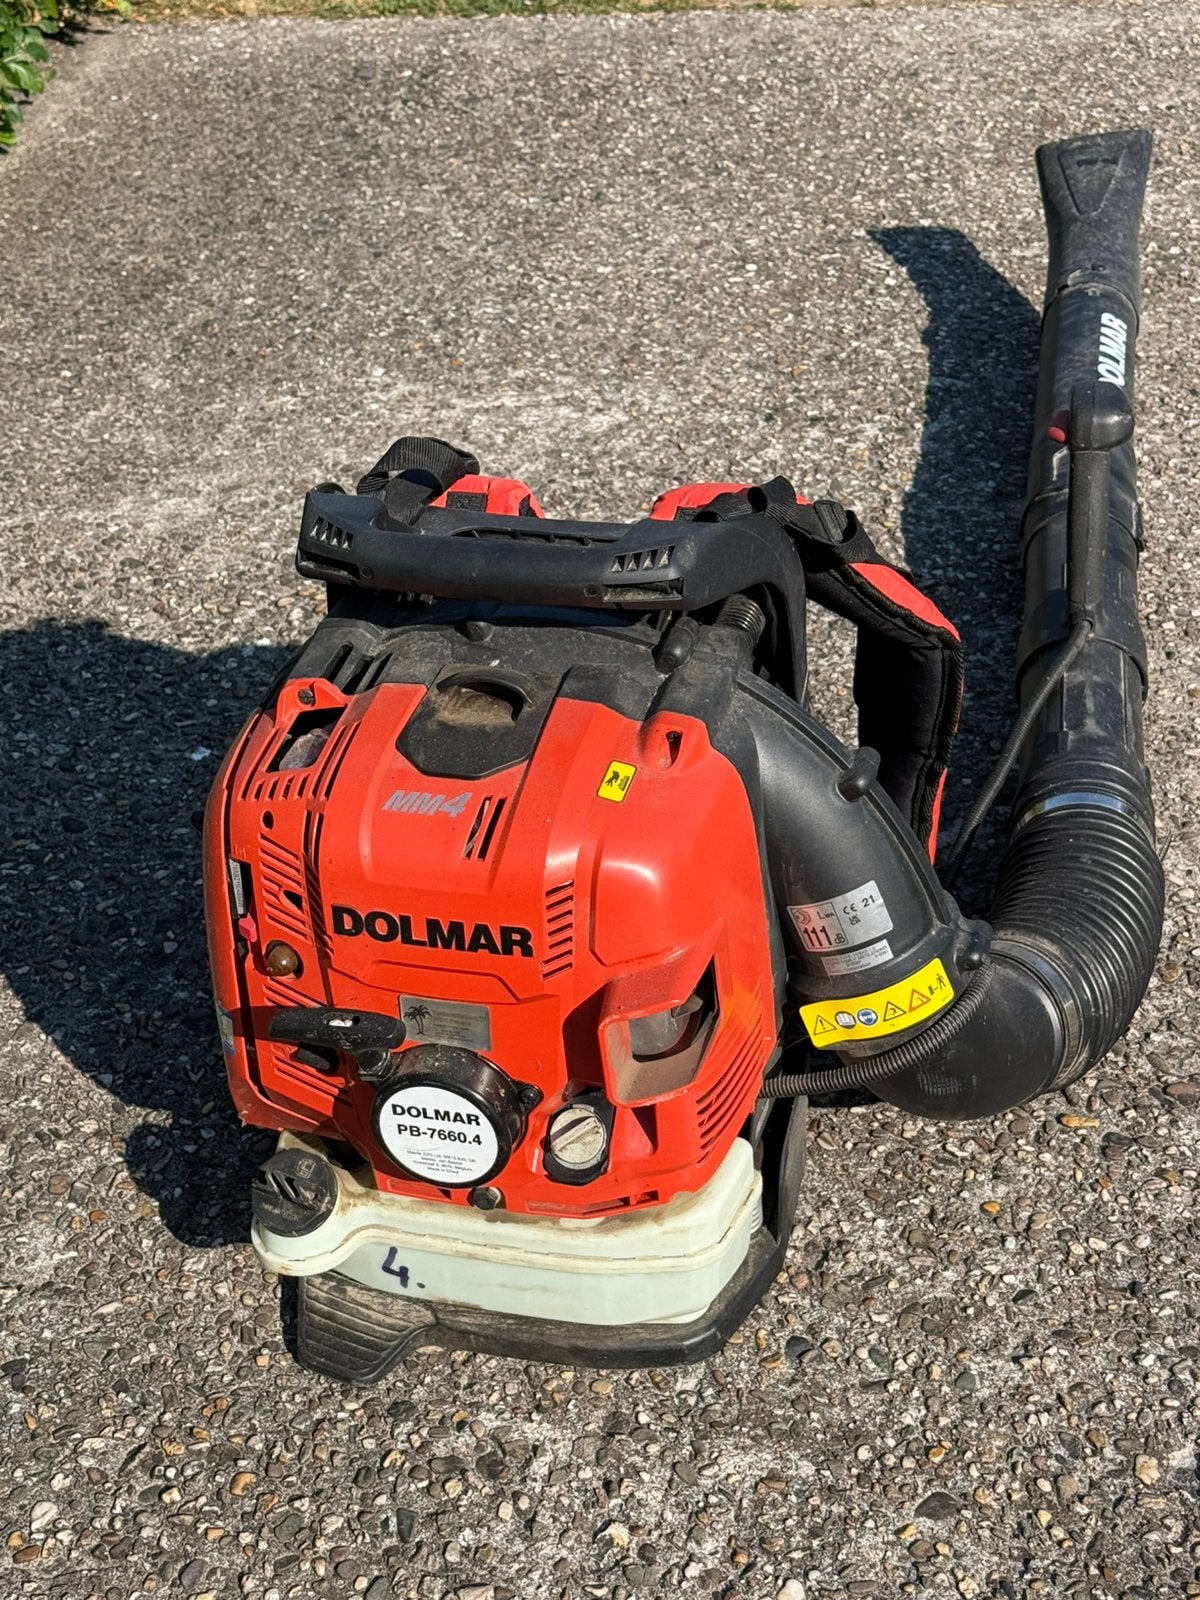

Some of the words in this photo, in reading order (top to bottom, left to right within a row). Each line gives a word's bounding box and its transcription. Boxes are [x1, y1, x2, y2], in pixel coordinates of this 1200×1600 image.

[382, 790, 474, 818] MM4
[862, 894, 875, 908] 21
[331, 904, 534, 958] DOLMAR
[803, 926, 833, 947] 111
[391, 1103, 481, 1126] DOLMAR
[397, 1123, 482, 1146] PB-7660.4
